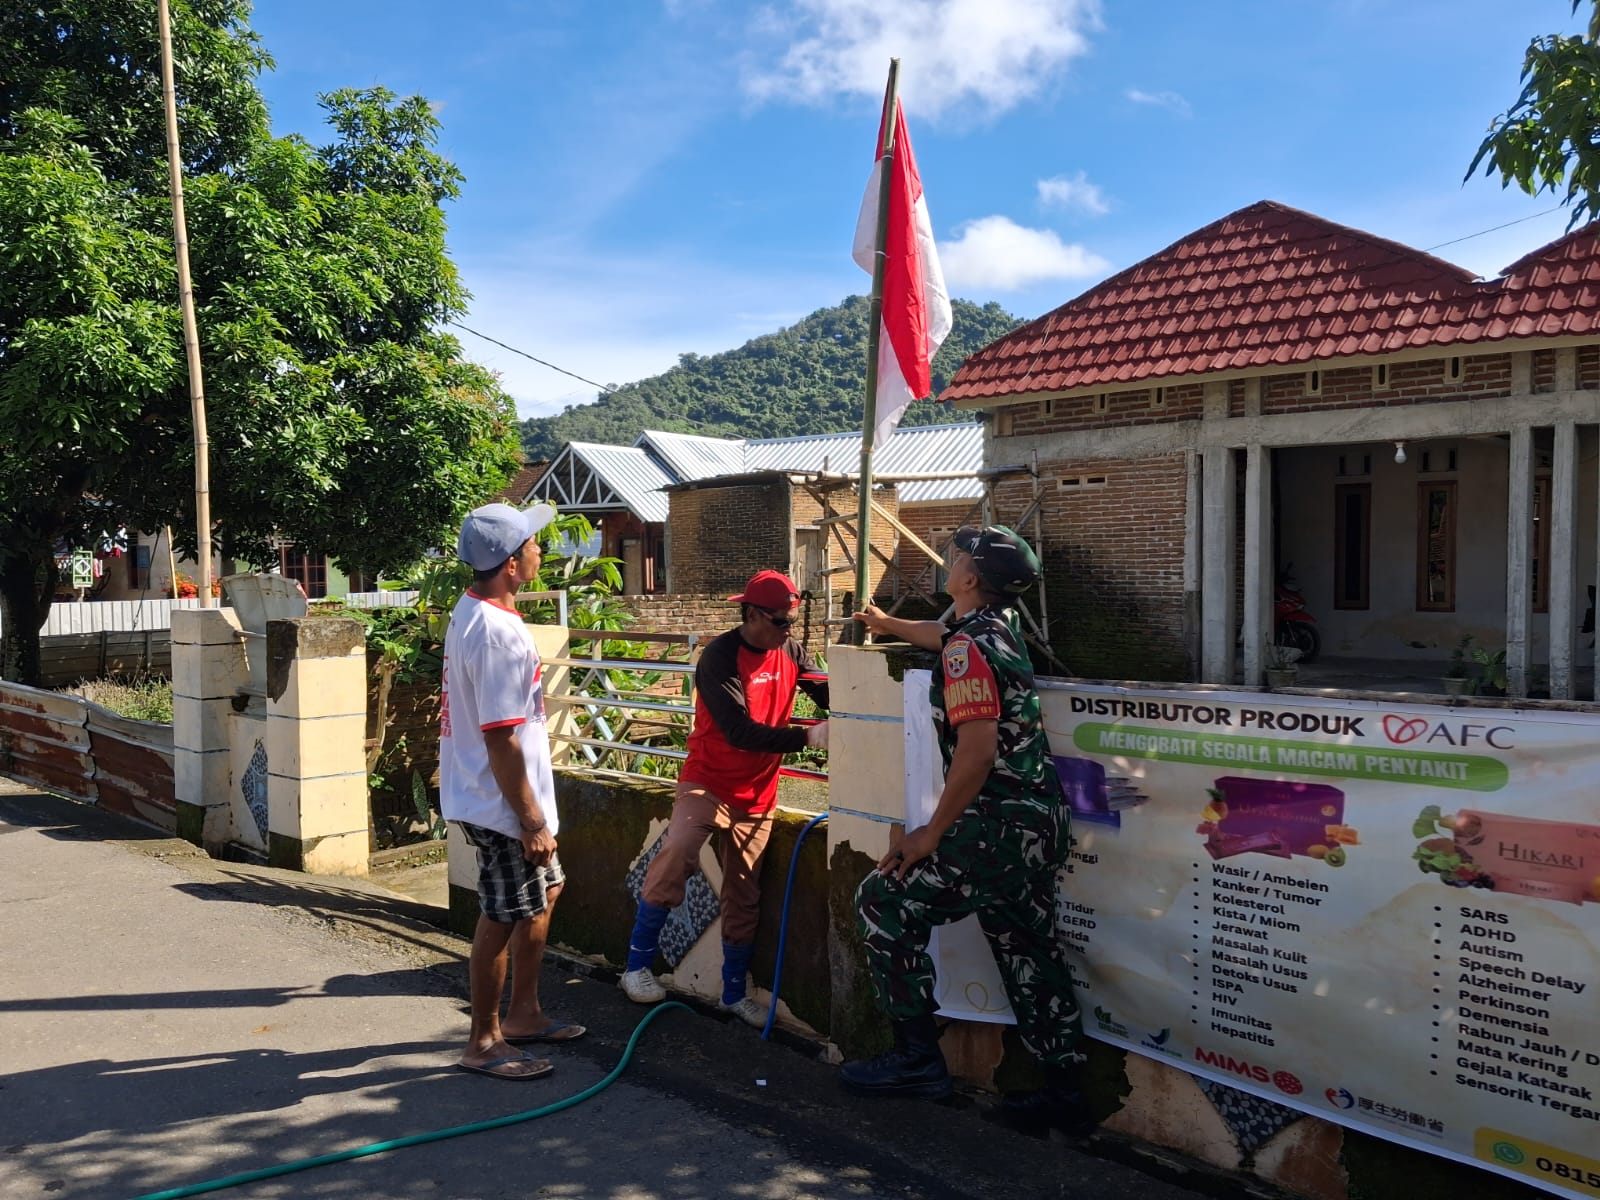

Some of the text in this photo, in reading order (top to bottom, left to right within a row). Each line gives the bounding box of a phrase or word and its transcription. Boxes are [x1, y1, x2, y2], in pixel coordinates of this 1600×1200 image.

[1070, 697, 1365, 737] DISTRIBUTOR PRODUK
[1426, 722, 1516, 750] AFC
[1100, 730, 1469, 781] MENGOBATI SEGALA MACAM PENYAKIT
[1499, 842, 1584, 869] HIKARI
[1212, 863, 1250, 878] Wasir
[1263, 873, 1329, 892] Ambeien
[1212, 878, 1260, 894] Kanker
[1273, 889, 1322, 906] Tumor
[1213, 892, 1285, 915] Kolesterol
[1064, 901, 1095, 915] Tidur
[1213, 906, 1247, 921] Kista
[1259, 915, 1300, 932] Miom
[1460, 907, 1509, 924] SARS
[1062, 915, 1096, 930] GERD
[1212, 921, 1268, 940] Jerawat
[1460, 924, 1517, 943] ADHD
[1212, 935, 1308, 964] Masalah Kulit
[1460, 941, 1523, 962] Autism
[1212, 950, 1308, 980] Masalah Usus
[1212, 964, 1298, 993] Detoks Usus
[1458, 957, 1586, 995] Speech Delay
[1212, 978, 1244, 994] ISPA
[1212, 992, 1237, 1006] HIV
[1458, 973, 1552, 1002] Alzheimer
[1458, 990, 1550, 1019] Perkinson
[1211, 1007, 1273, 1031] Imunitas
[1458, 1006, 1550, 1037] Demensia
[1211, 1021, 1275, 1047] Hepatitis
[1458, 1023, 1515, 1046] Rabun
[1519, 1038, 1567, 1058] Jauh
[1195, 1047, 1271, 1083] MIMS
[1457, 1039, 1569, 1078] Mata Kering
[1456, 1057, 1592, 1101] Gejala Katarak
[1456, 1073, 1534, 1103] Sensorik
